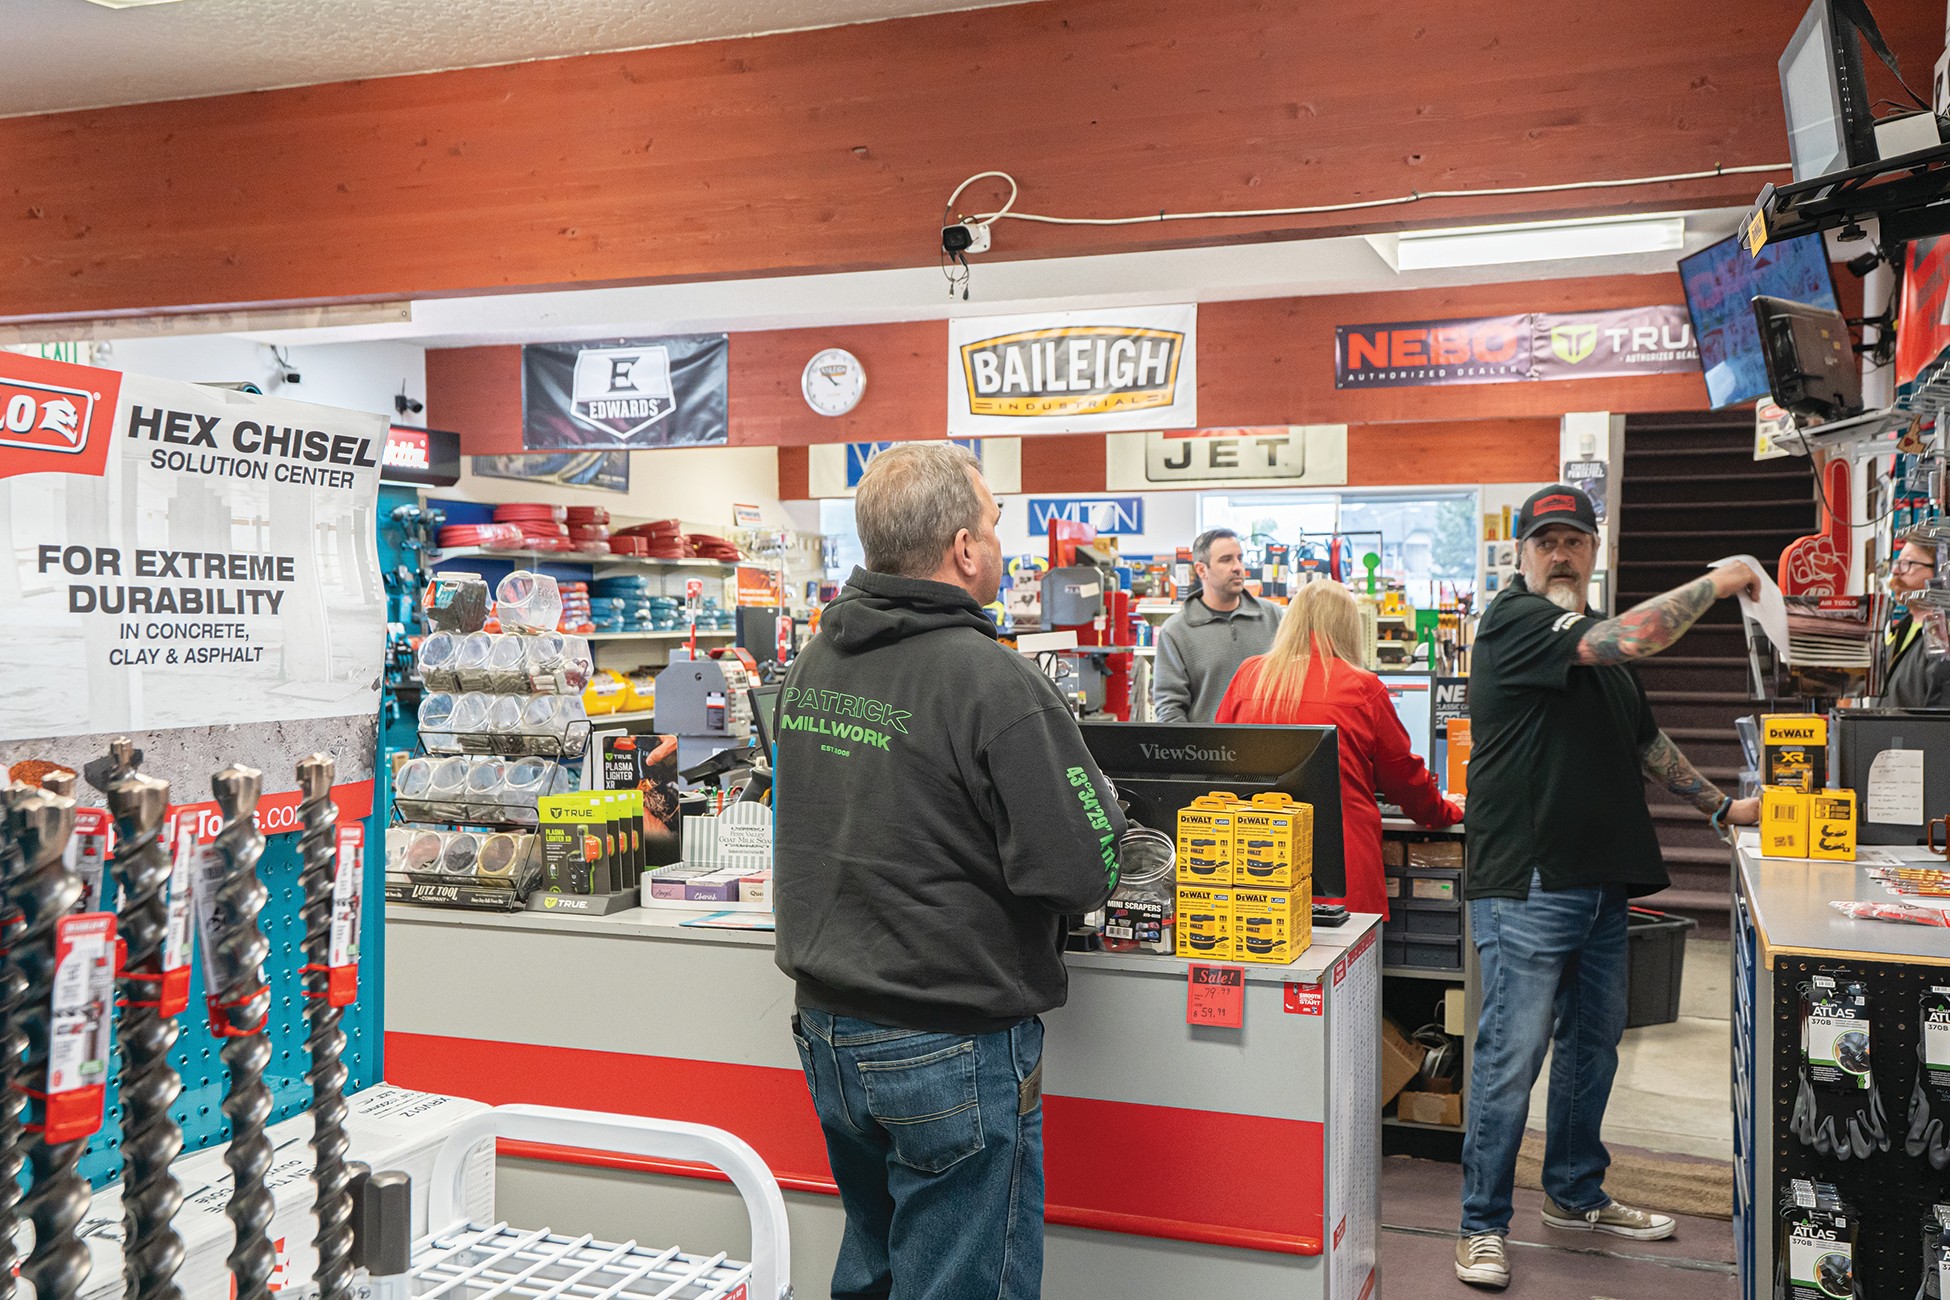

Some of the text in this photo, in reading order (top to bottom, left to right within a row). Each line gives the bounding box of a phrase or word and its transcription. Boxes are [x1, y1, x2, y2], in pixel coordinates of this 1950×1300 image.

[1604, 324, 1697, 353] TRU
[1348, 323, 1517, 369] NEBO
[1625, 352, 1674, 363] AUTHORIZED
[973, 338, 1171, 394] BAILEIGH
[1348, 365, 1517, 381] AUTHORIZED DEALER
[607, 356, 640, 393] E
[589, 398, 660, 419] EDWARDS
[998, 397, 1140, 410] INDUSTRIAL
[128, 405, 377, 467] HEX CHISEL
[1164, 438, 1290, 469] JET
[150, 449, 355, 490] SOLUTION CENTER
[38, 544, 295, 582] FOR EXTREME
[68, 584, 285, 615] DURABILITY
[120, 623, 250, 641] IN CONCRETE,
[109, 646, 263, 666] CLAY & ASPHALT
[783, 687, 913, 734] PATRICK
[781, 714, 892, 752] MILLWORK
[1770, 729, 1815, 738] DEWALT
[1140, 743, 1237, 762] ViewSonic
[1781, 751, 1805, 763] XR
[605, 762, 634, 772] PLASMA
[606, 771, 633, 780] LIGHTER
[606, 781, 615, 789] XR
[564, 809, 593, 817] TRUE
[1180, 815, 1212, 824] DEWALT
[1237, 816, 1269, 825] DEWALT
[412, 884, 435, 898] LUTZ
[437, 886, 459, 901] TOOL
[1179, 891, 1211, 900] DEWALT
[1235, 894, 1268, 903] DEWALT
[558, 900, 588, 909] TRUE
[1107, 900, 1162, 912] MINI SCRAPERS
[1199, 969, 1235, 985] Sale!
[1812, 1006, 1856, 1019] ATLAS
[1929, 1012, 1950, 1023] ATL
[1811, 1018, 1832, 1026] 370B
[1927, 1024, 1949, 1032] 370B
[1793, 1226, 1837, 1241] ATLAS
[1792, 1238, 1813, 1247] 370B
